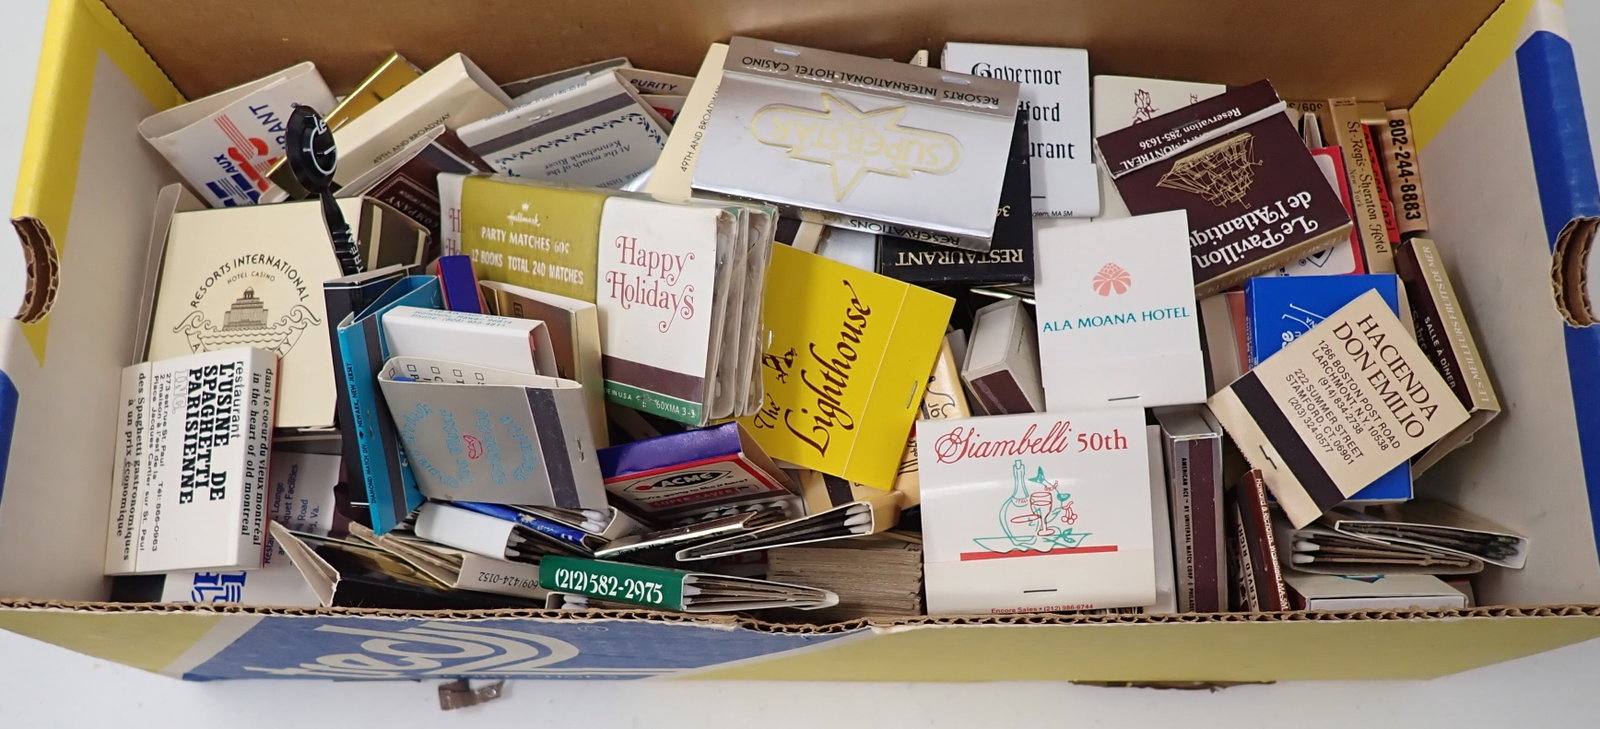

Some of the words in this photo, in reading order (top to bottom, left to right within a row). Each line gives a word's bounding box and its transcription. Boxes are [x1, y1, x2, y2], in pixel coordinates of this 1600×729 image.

[741, 56, 789, 71] CASINO
[795, 64, 837, 80] HOTEL
[971, 62, 1062, 86] Governor
[630, 78, 678, 92] PURITY
[837, 71, 937, 97] INTERNATIONAL
[941, 89, 999, 106] RESORTS
[1183, 107, 1242, 136] Réservation
[373, 152, 391, 165] 49TH
[392, 140, 409, 154] AND
[409, 113, 450, 144] BROADWAY
[604, 148, 618, 158] the
[620, 144, 631, 153] At
[681, 151, 694, 173] 49TH
[690, 131, 704, 152] AND
[772, 116, 944, 167] SUPERSTAR
[1139, 129, 1182, 151] 285-1636
[574, 155, 601, 169] mouth
[1389, 119, 1421, 221] 802-244-8883
[1287, 191, 1313, 211] de
[507, 210, 541, 228] Hallmark
[849, 218, 960, 247] RESERVATIONS
[1190, 201, 1290, 246] l'Atlantiqu
[1280, 215, 1319, 237] Le
[481, 226, 507, 243] PARTY
[509, 232, 551, 252] MATCHES
[1192, 228, 1285, 270] Pavillon
[1369, 223, 1388, 254] Hotel
[480, 250, 503, 268] BOOKS
[507, 255, 530, 273] TOTAL
[532, 260, 546, 277] 240
[549, 263, 584, 285] MATCHES
[615, 235, 696, 287] Happy
[895, 248, 1024, 267] RESTAURANT
[190, 262, 231, 309] RESORTS
[234, 253, 310, 302] INTERNATIONAL
[227, 272, 248, 285] HOTEL
[251, 270, 276, 283] CASINO
[605, 270, 695, 334] Holidays
[1042, 319, 1073, 333] ALA
[1077, 312, 1137, 330] MOANA
[1142, 306, 1191, 321] HOTEL
[1424, 316, 1440, 346] SALLE
[1440, 358, 1456, 389] DÎNER
[138, 372, 146, 394] des
[253, 372, 261, 384] in
[264, 368, 274, 394] dans
[754, 393, 782, 429] The
[784, 279, 872, 458] Lighthouse
[1332, 321, 1377, 372] DON
[1367, 369, 1425, 438] EMILIO
[1356, 314, 1439, 422] HACIENDA
[152, 375, 160, 402] Place
[231, 361, 244, 439] restaurant
[251, 387, 260, 406] the
[1312, 349, 1357, 409] LARCHMONT,
[1354, 407, 1371, 427] N.Y.
[1368, 425, 1389, 451] 10538
[1318, 339, 1335, 361] 1266
[1332, 358, 1365, 400] BOSTON
[1359, 393, 1381, 423] POST
[1377, 421, 1401, 449] ROAD
[126, 409, 133, 426] un
[214, 363, 235, 447] L'USINE
[1285, 374, 1325, 425] STAMFORD,
[1322, 424, 1335, 441] CT.
[1333, 438, 1354, 466] 06901
[1294, 368, 1310, 385] 222
[1306, 384, 1337, 425] SUMMER
[1334, 421, 1365, 459] STREET
[1318, 376, 1337, 399] (914)
[1333, 397, 1364, 435] 834-2738
[134, 396, 146, 456] Spaghetti
[147, 406, 156, 449] Jacques
[179, 367, 203, 504] PARISIENNE
[195, 365, 218, 489] SPAGHETTI
[249, 410, 259, 440] heart
[261, 408, 271, 441] coeur
[1287, 396, 1306, 418] (203)
[1303, 415, 1334, 454] 324-0577
[124, 431, 133, 457] prix
[247, 444, 257, 456] of
[260, 441, 269, 457] du
[1077, 429, 1129, 453] 50th
[145, 452, 153, 486] Cartier
[245, 460, 254, 478] old
[257, 458, 268, 490] vieux
[661, 471, 713, 488] ACME
[116, 458, 132, 538] économique
[210, 471, 227, 501] DE
[123, 460, 141, 561] gastronomiques
[241, 482, 251, 536] montreal
[253, 491, 264, 546] montréal
[298, 499, 309, 521] Road
[139, 528, 147, 551] Paul
[479, 571, 539, 591] 609/424-0152
[1017, 605, 1038, 613] Sales
[1043, 605, 1061, 613] (212)
